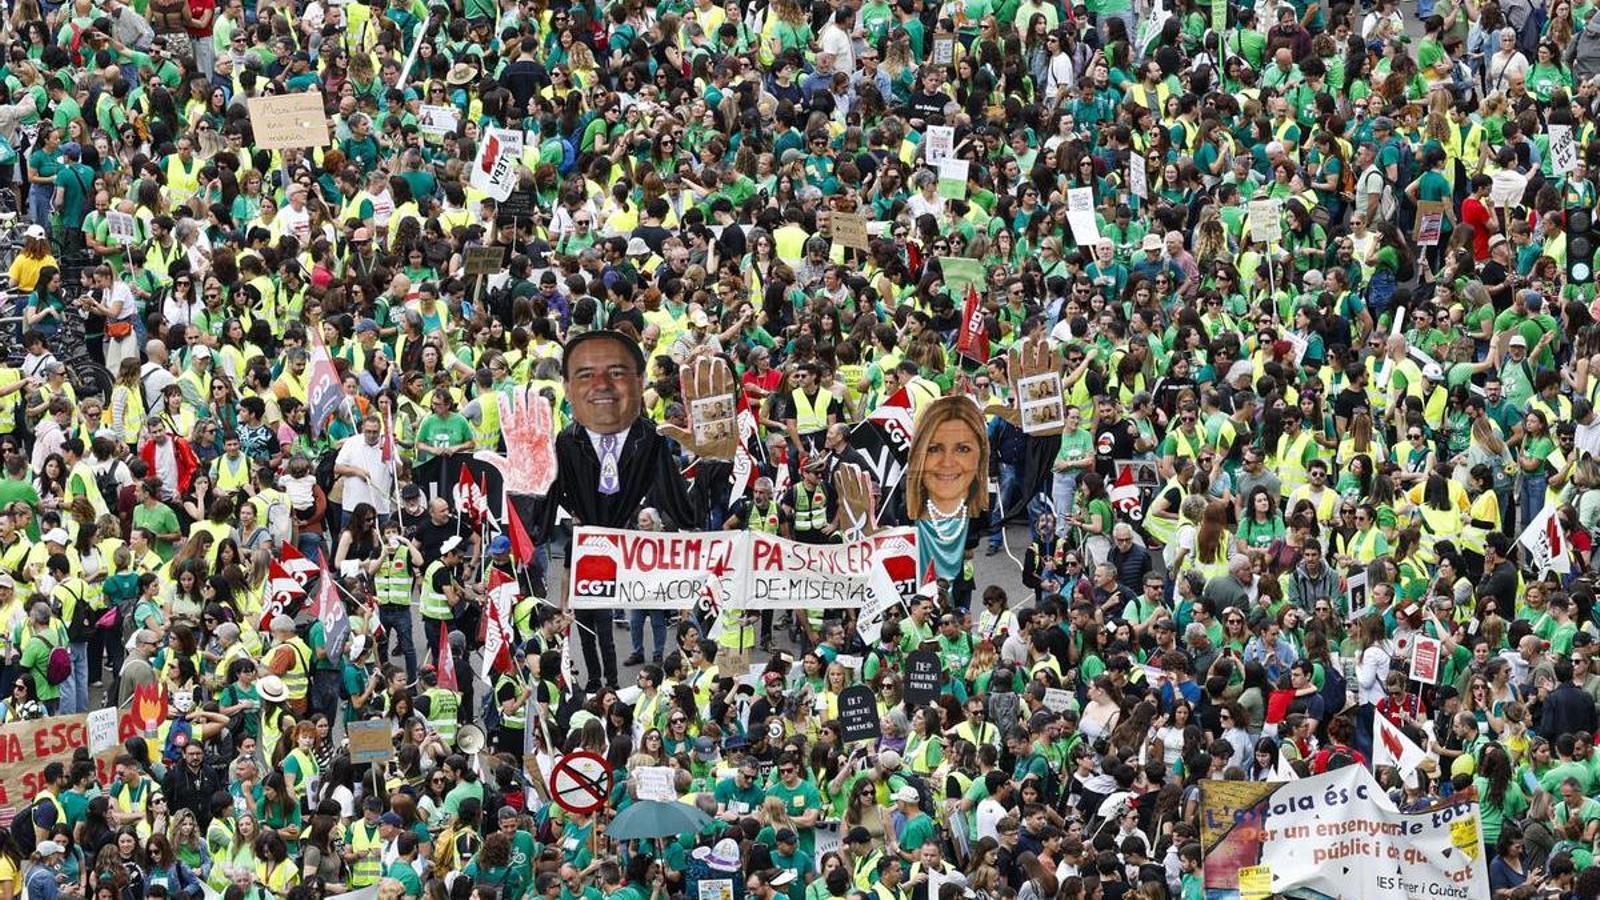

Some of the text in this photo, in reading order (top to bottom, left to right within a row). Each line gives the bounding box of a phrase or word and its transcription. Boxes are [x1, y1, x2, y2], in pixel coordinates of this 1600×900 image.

[885, 419, 911, 452] CGT
[1120, 498, 1143, 520] CG
[620, 535, 701, 572] VOLEM
[753, 540, 783, 571] PA
[788, 542, 873, 575] SENCER
[576, 580, 617, 597] CGT
[620, 581, 646, 602] NO
[654, 579, 731, 602] ACORS
[755, 578, 782, 601] DE
[34, 714, 138, 758] ESCA
[1324, 784, 1349, 805] és
[1284, 825, 1310, 840] un
[1313, 838, 1371, 864] públic
[1376, 875, 1394, 890] IES
